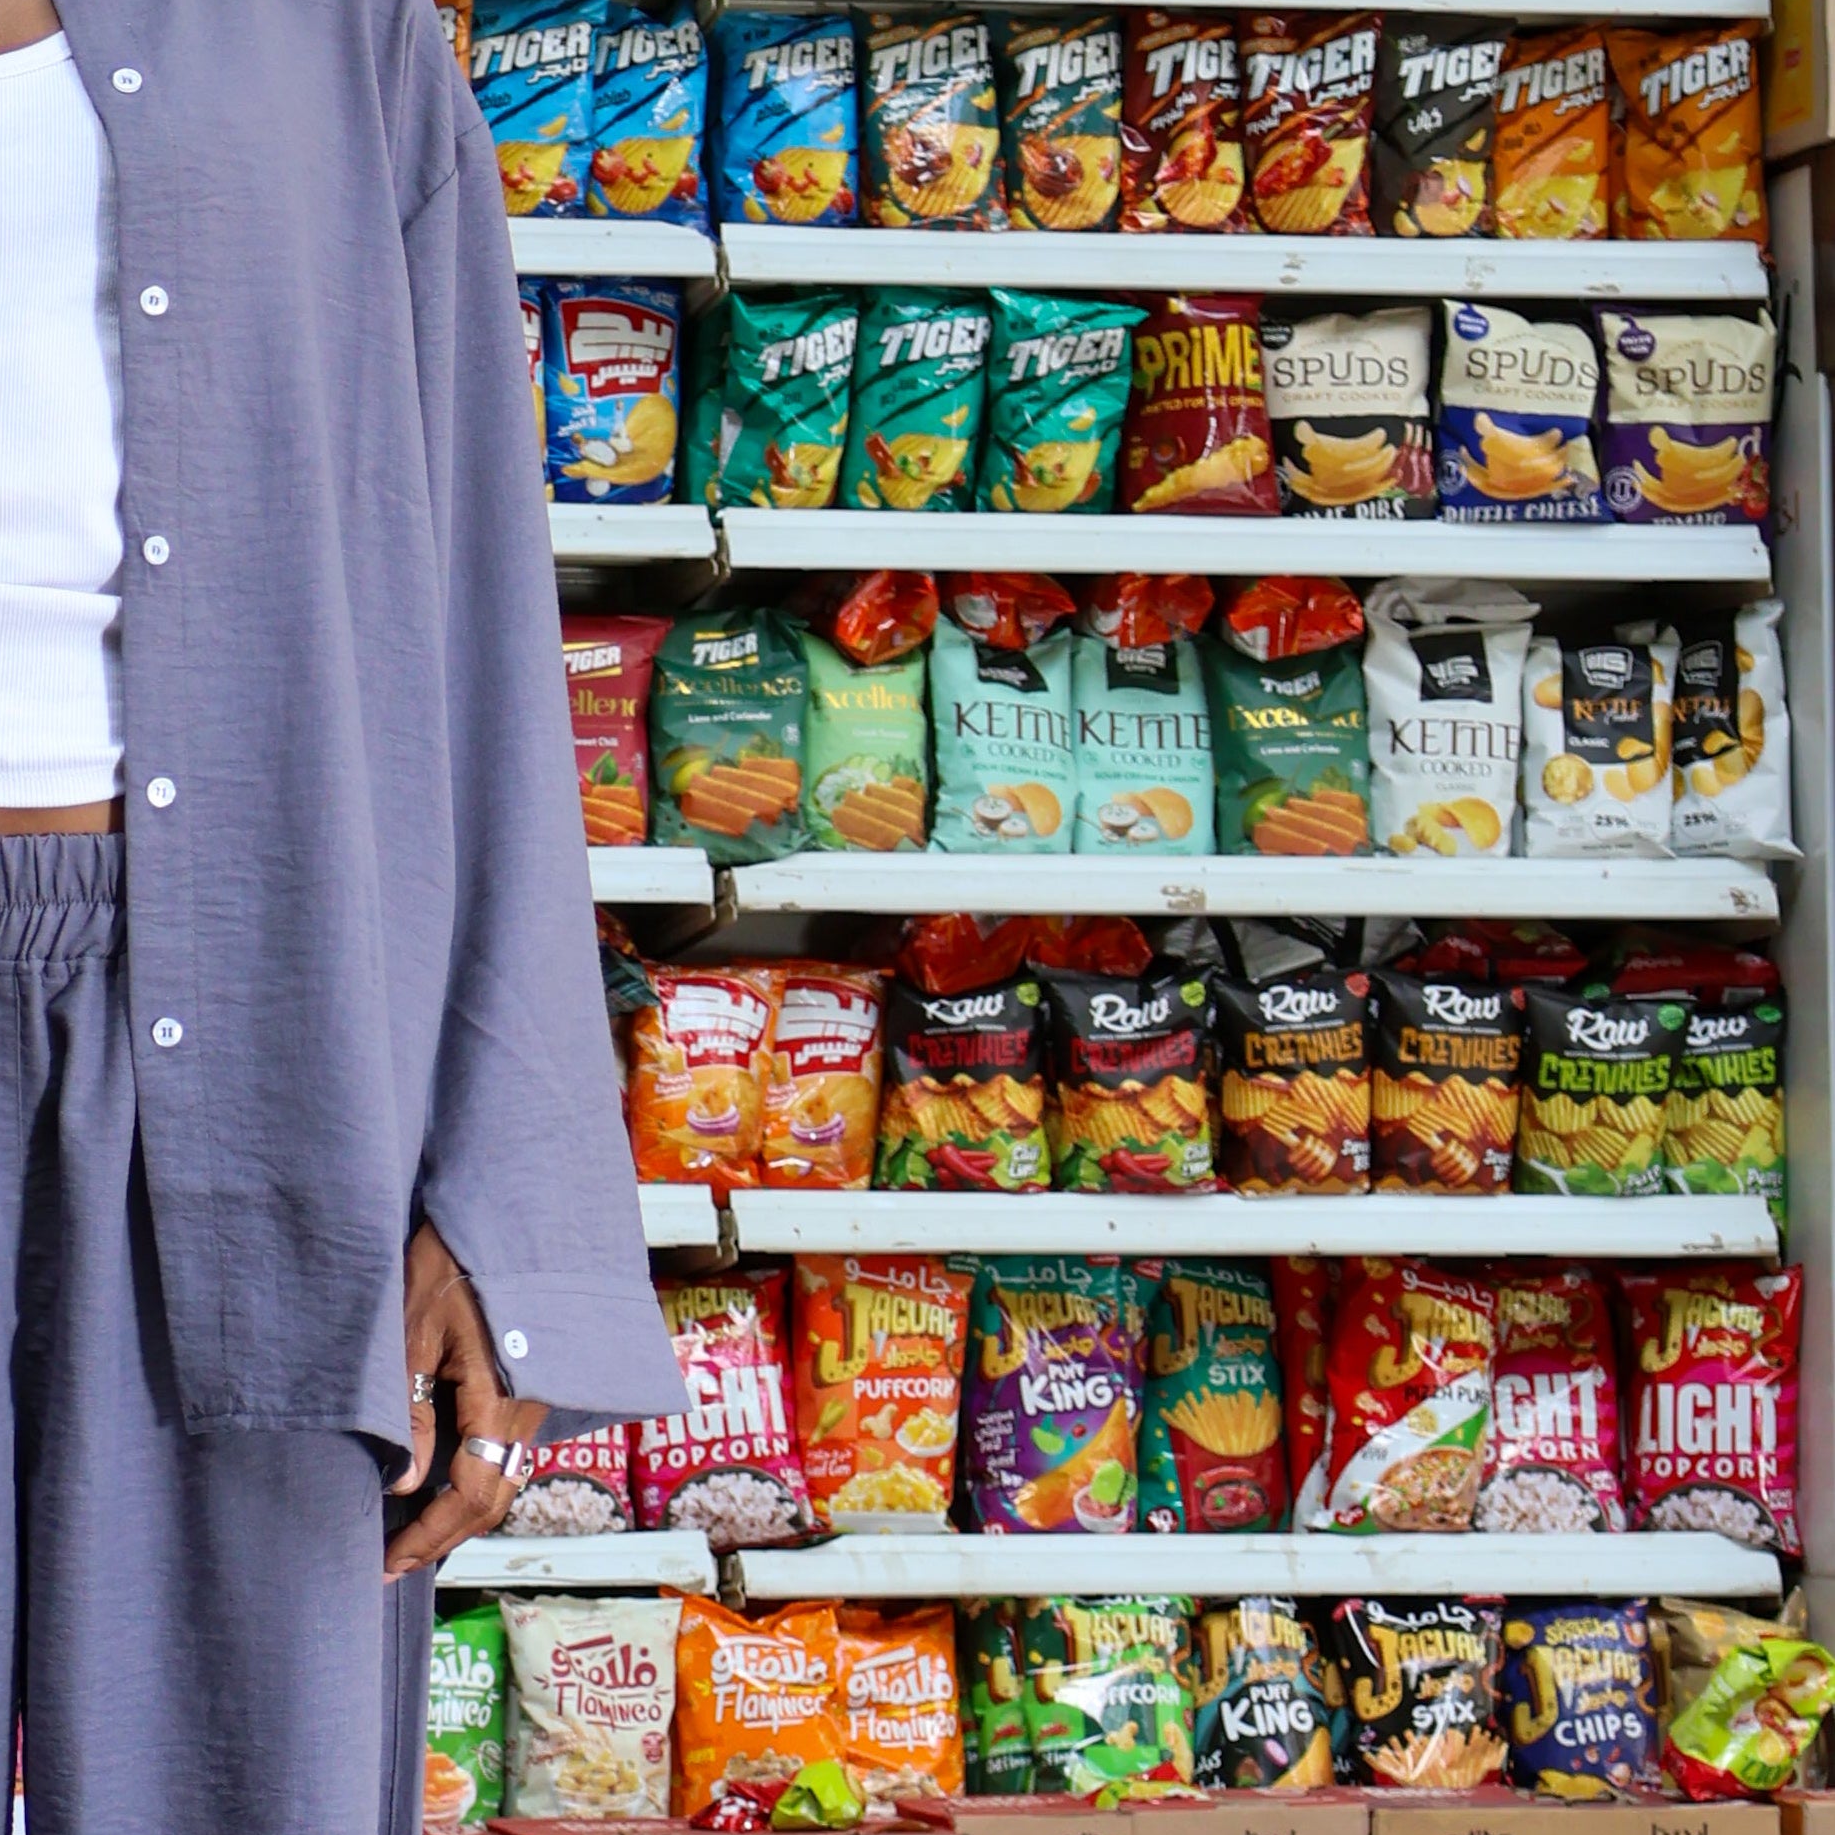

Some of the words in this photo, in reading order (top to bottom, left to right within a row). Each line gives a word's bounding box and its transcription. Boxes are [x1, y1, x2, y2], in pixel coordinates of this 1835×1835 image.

[471, 22, 592, 80] TIGER
[1640, 39, 1752, 116] TIGER
[1006, 326, 1126, 382] TIGER
[1134, 324, 1261, 392] PRIME
[1273, 351, 1409, 387] SPUDS
[1467, 347, 1600, 388] SPUDS
[692, 633, 760, 667] TIGER
[1078, 709, 1211, 750] KETTLE
[1389, 720, 1518, 762] KETTLE
[1110, 750, 1182, 769] COOKED
[1420, 760, 1492, 779] COOKED
[1090, 992, 1171, 1034] Raw
[1260, 984, 1339, 1023] Raw
[814, 1284, 958, 1388] JAGUAR
[853, 1377, 955, 1401] PUFFCORN
[1208, 1364, 1266, 1385] STIX
[1639, 1382, 1780, 1455] LIGHT
[1641, 1456, 1777, 1479] POPCORN
[1221, 1698, 1315, 1741] KING
[1554, 1710, 1643, 1748] CHIPS
